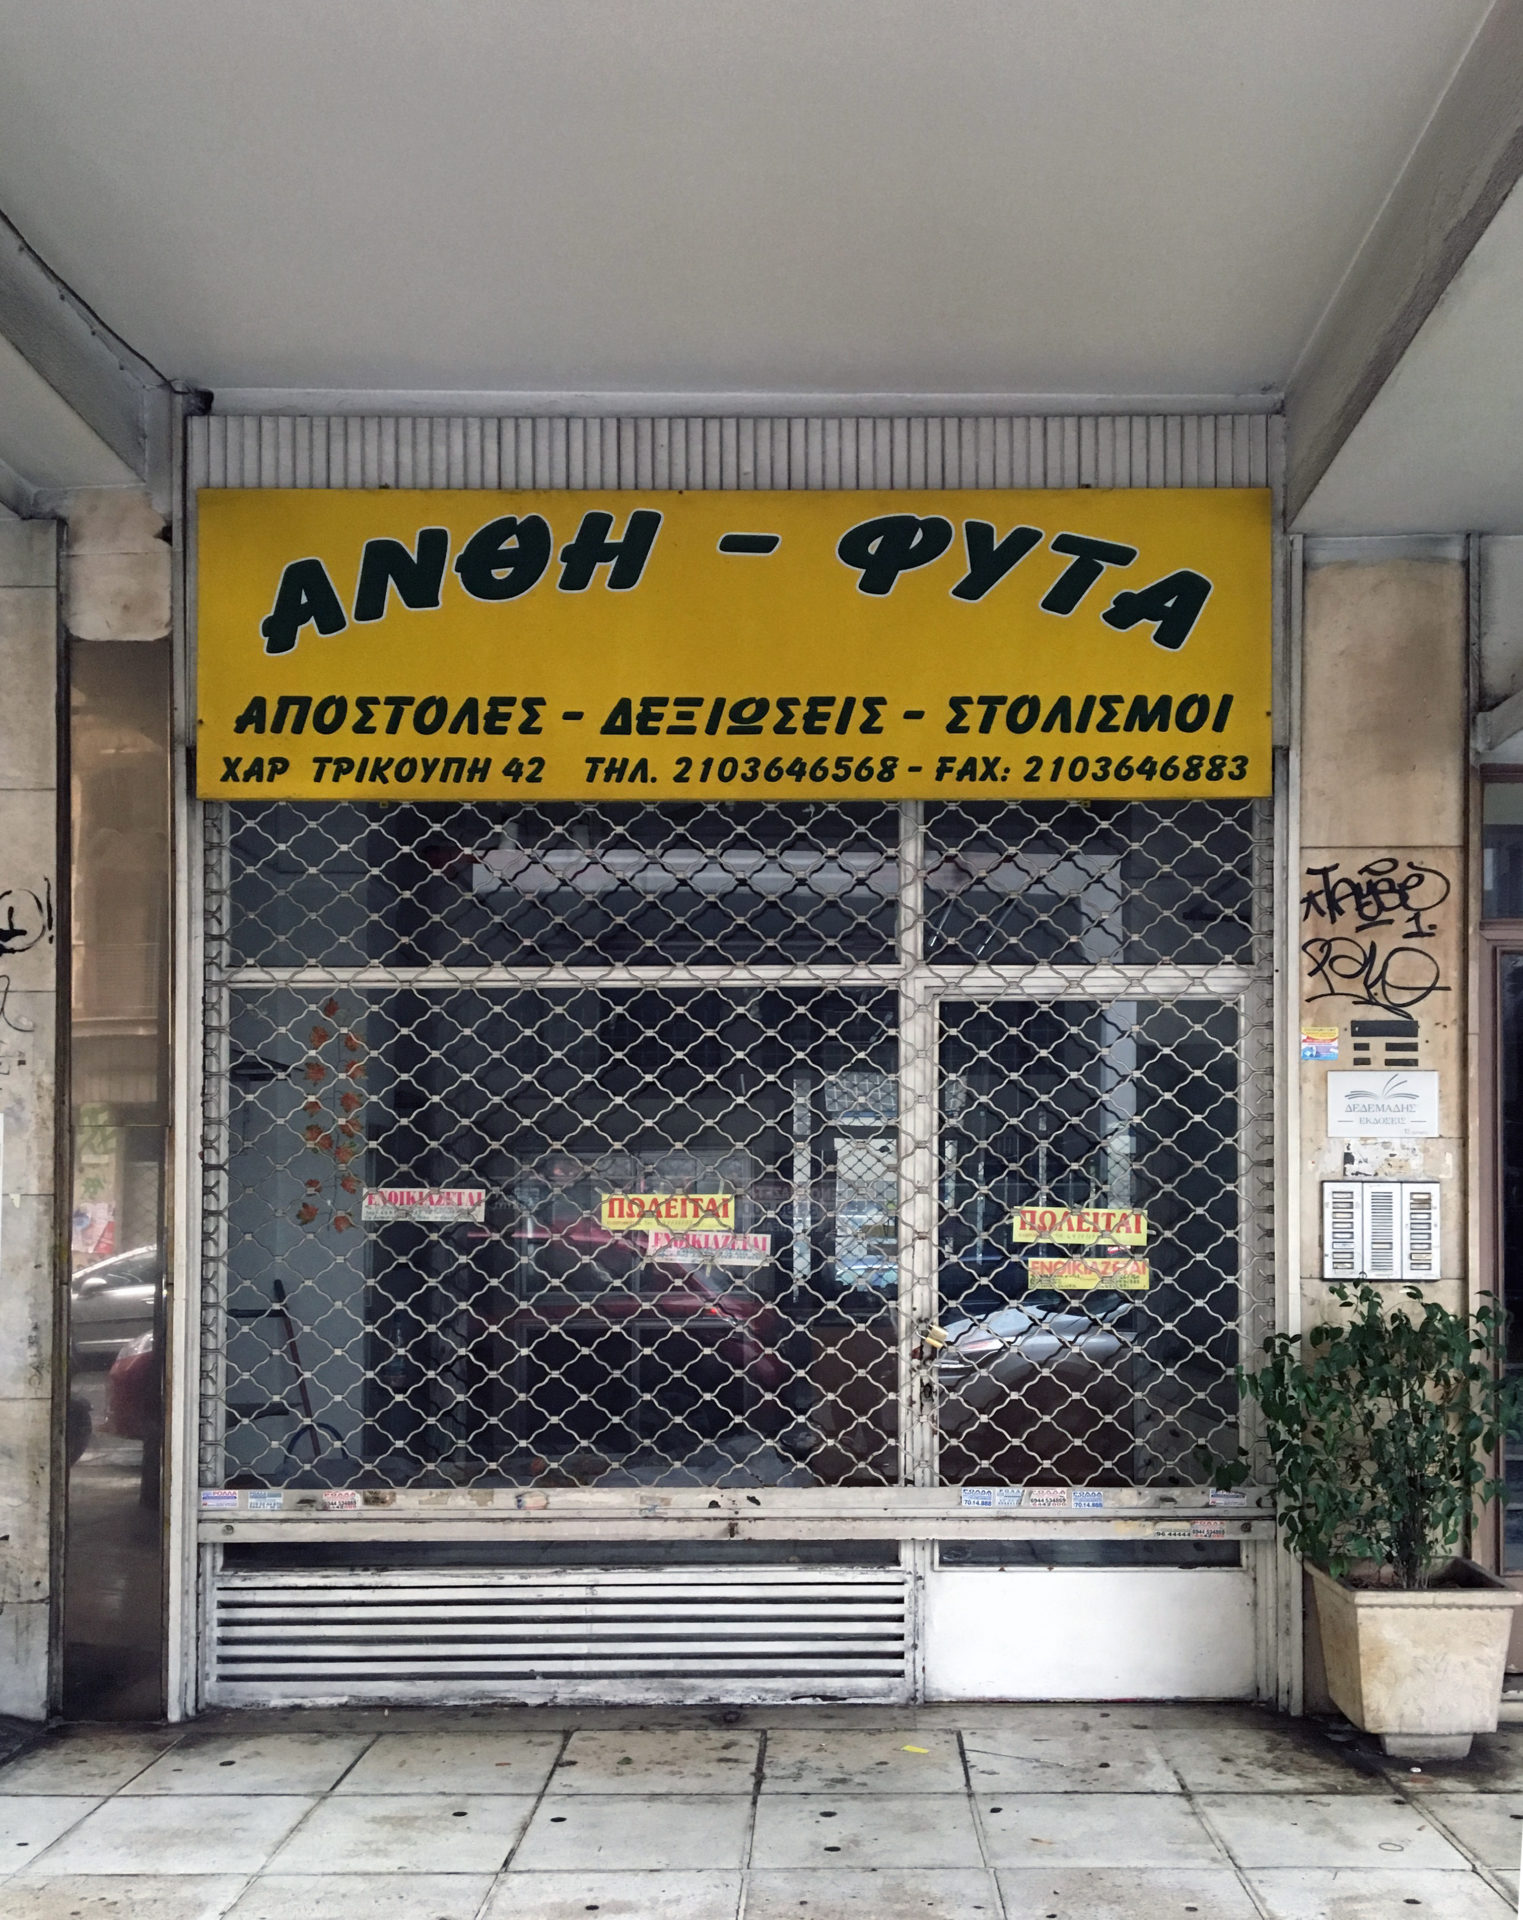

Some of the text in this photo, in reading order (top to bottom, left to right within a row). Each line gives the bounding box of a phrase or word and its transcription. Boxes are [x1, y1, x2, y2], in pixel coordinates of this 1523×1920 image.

[260, 509, 664, 656] ΑΝΘΗ
[836, 513, 1214, 652] ΦΥΤΑ
[233, 694, 547, 736] ΑΠΟΣΤΟΛΕΣ
[599, 695, 888, 736] ΔΕΞΙΩΣΕΙΣ
[945, 693, 1235, 735] ΣΤΟΛΙΣΜΟΙ
[219, 756, 290, 784] ΧΑΡ
[312, 756, 493, 785] ΤΡΙΚΟΥΠΗ
[501, 756, 546, 784] 42
[584, 756, 658, 784] ΤΗΛ.
[672, 755, 899, 783] 2103646568
[934, 755, 1011, 783] FAX:
[1023, 754, 1249, 783] 2103646883
[1344, 1103, 1417, 1113] ΔΕΔΕΜΑΔΗΣ
[1359, 1116, 1407, 1125] ΕΚΔΟΣΕΙΣ
[607, 1197, 731, 1219] ΠΩΛΕΙΤΑΙ
[1018, 1209, 1143, 1234] ΠΩΛΕΙΤΑΙ
